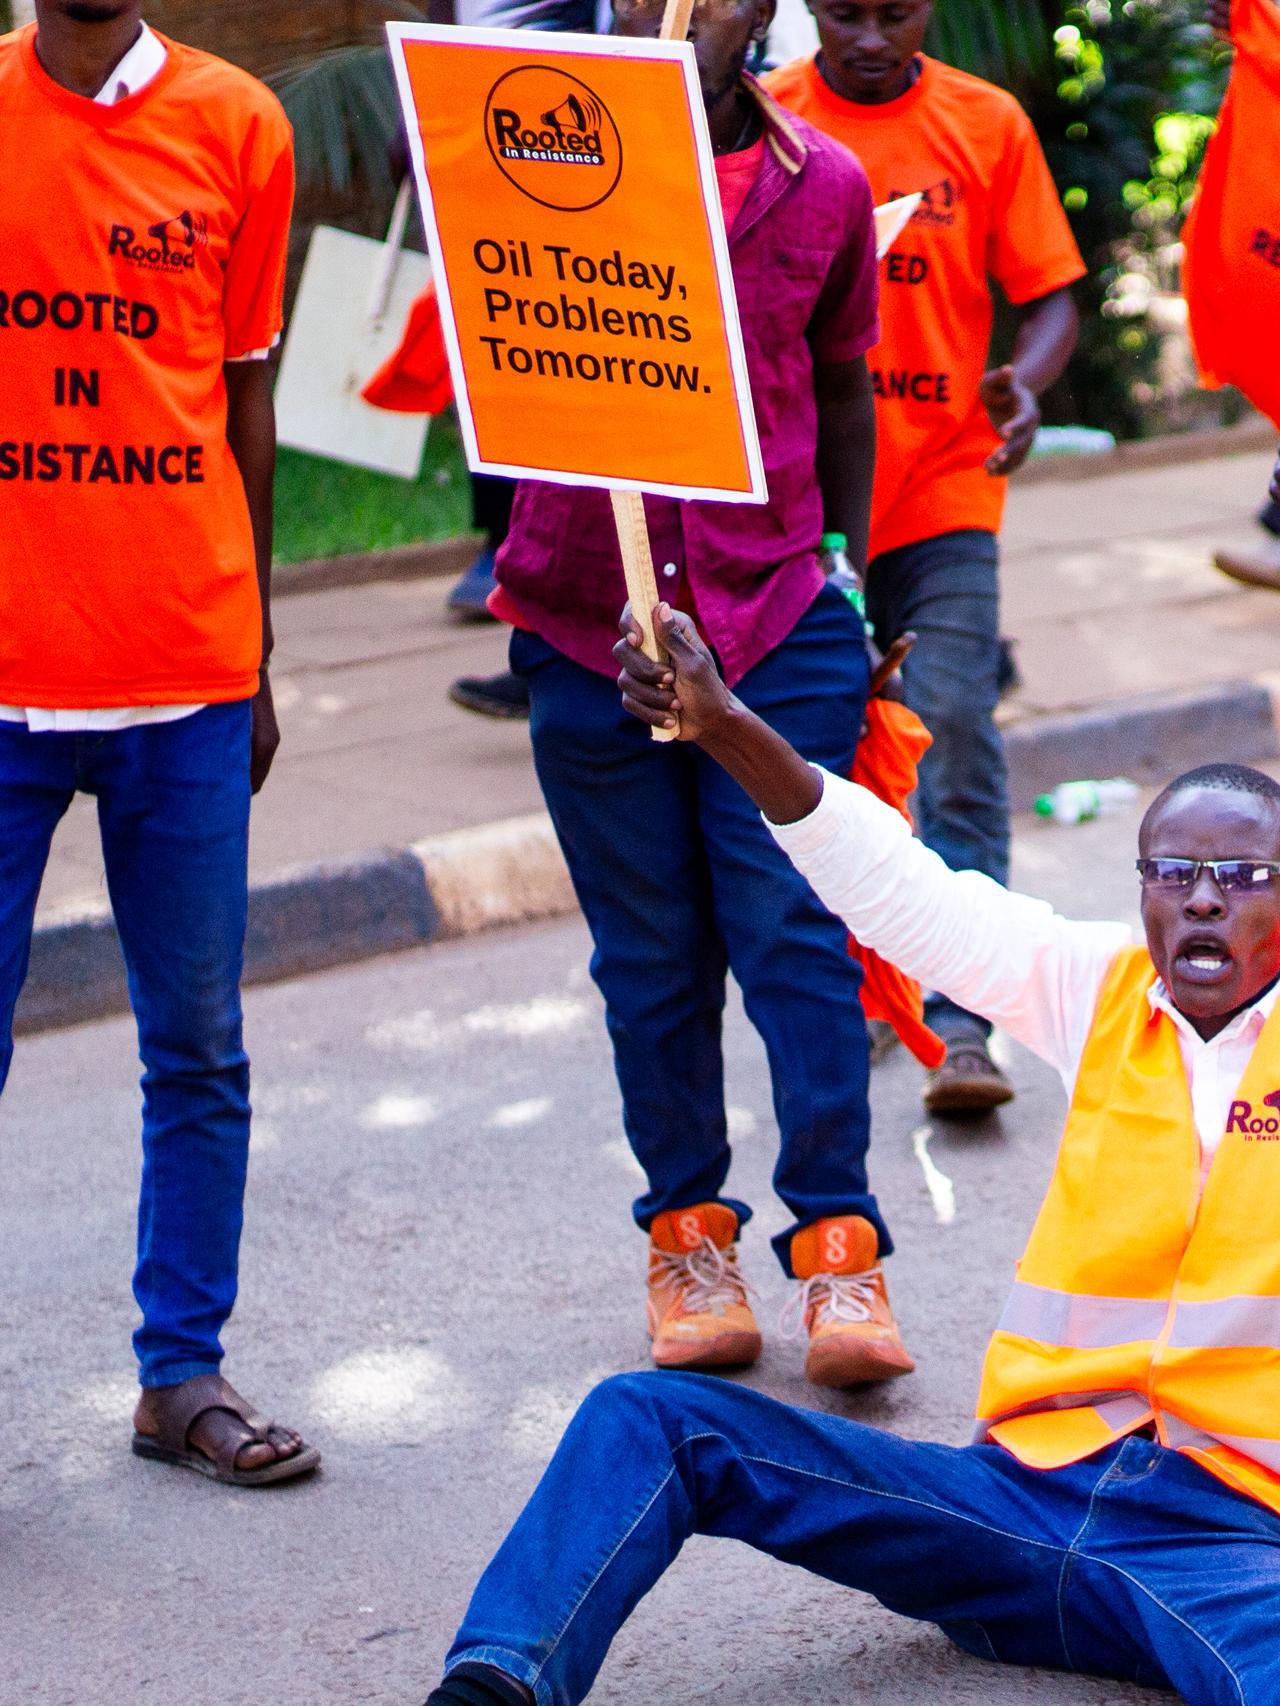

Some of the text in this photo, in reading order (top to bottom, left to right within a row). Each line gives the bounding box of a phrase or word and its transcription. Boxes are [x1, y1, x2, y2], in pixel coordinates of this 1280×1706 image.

[492, 108, 603, 154] Rooted
[505, 147, 600, 164] In Resistance
[108, 224, 195, 269] Rooted
[473, 238, 687, 301] Oil Today,
[484, 287, 692, 343] Problems
[54, 367, 99, 407] IN
[479, 335, 712, 394] Tomorrow.
